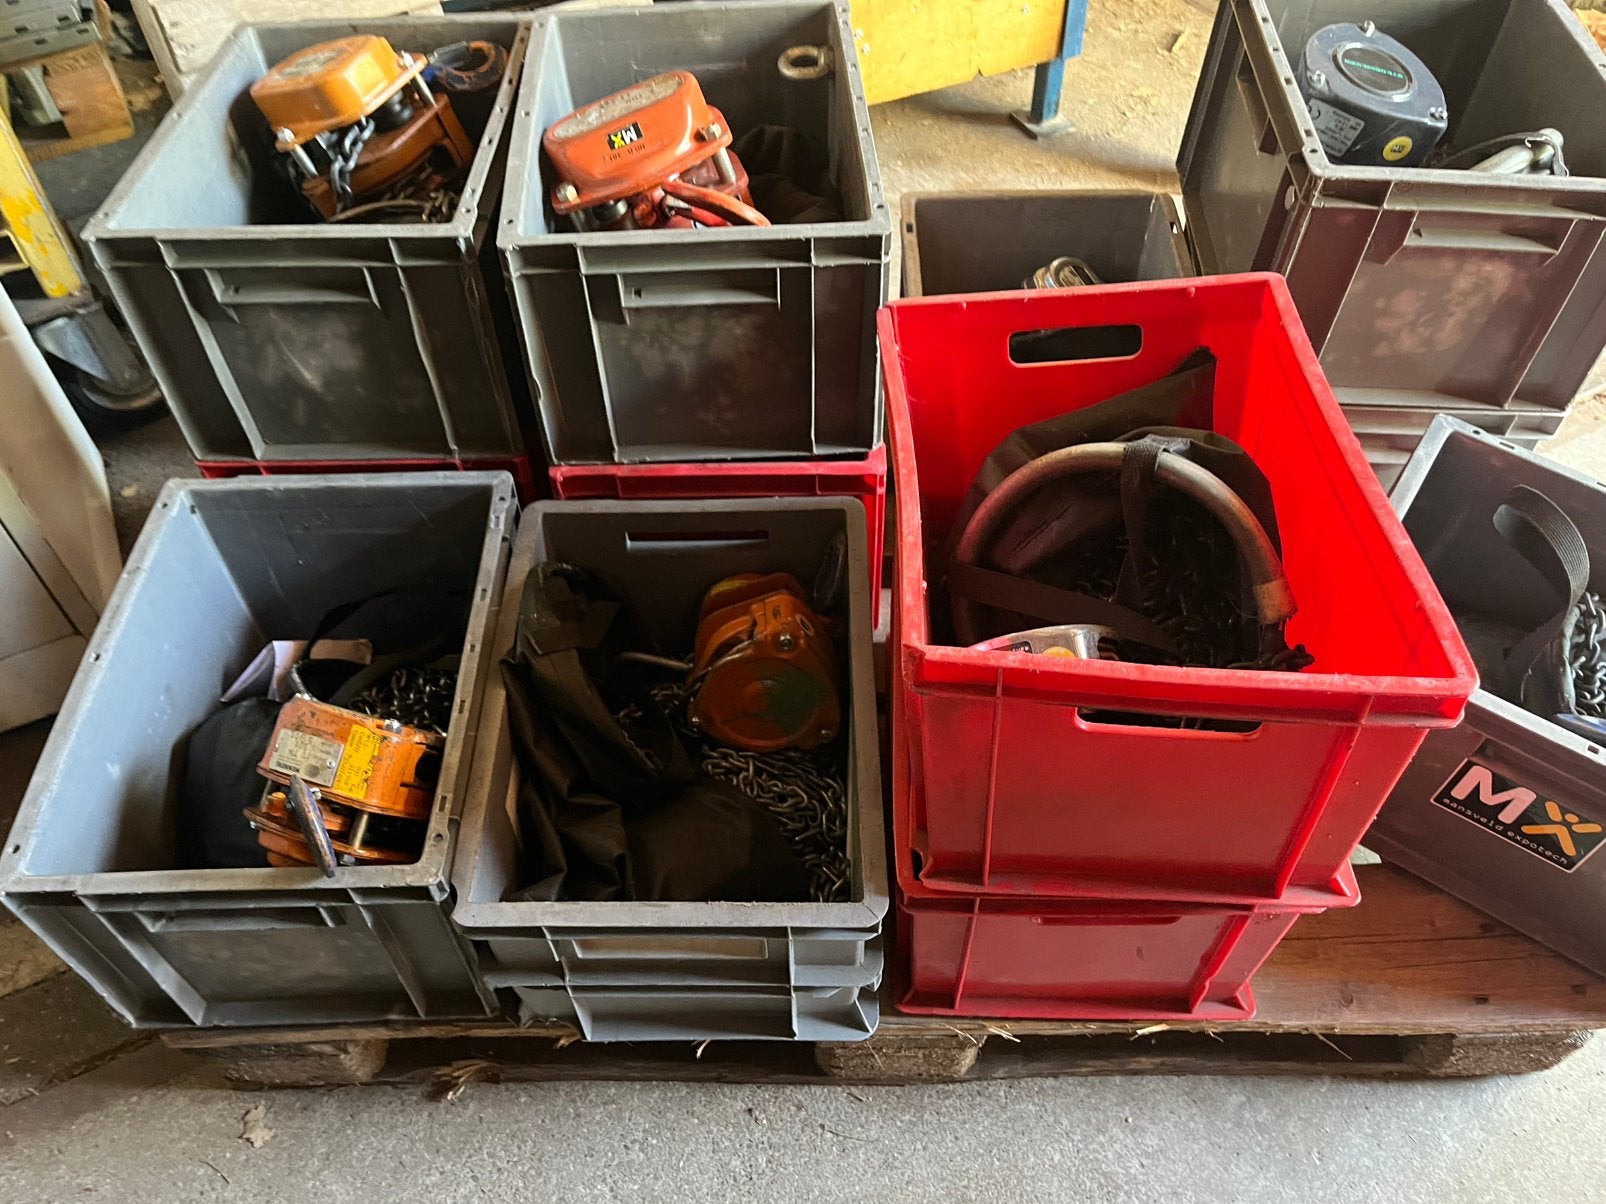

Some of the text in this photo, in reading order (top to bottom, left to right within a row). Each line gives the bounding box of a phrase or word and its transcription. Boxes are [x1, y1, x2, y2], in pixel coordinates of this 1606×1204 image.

[610, 125, 638, 149] MX
[1443, 797, 1568, 865] mansveld expotech
[1450, 765, 1603, 857] MX
